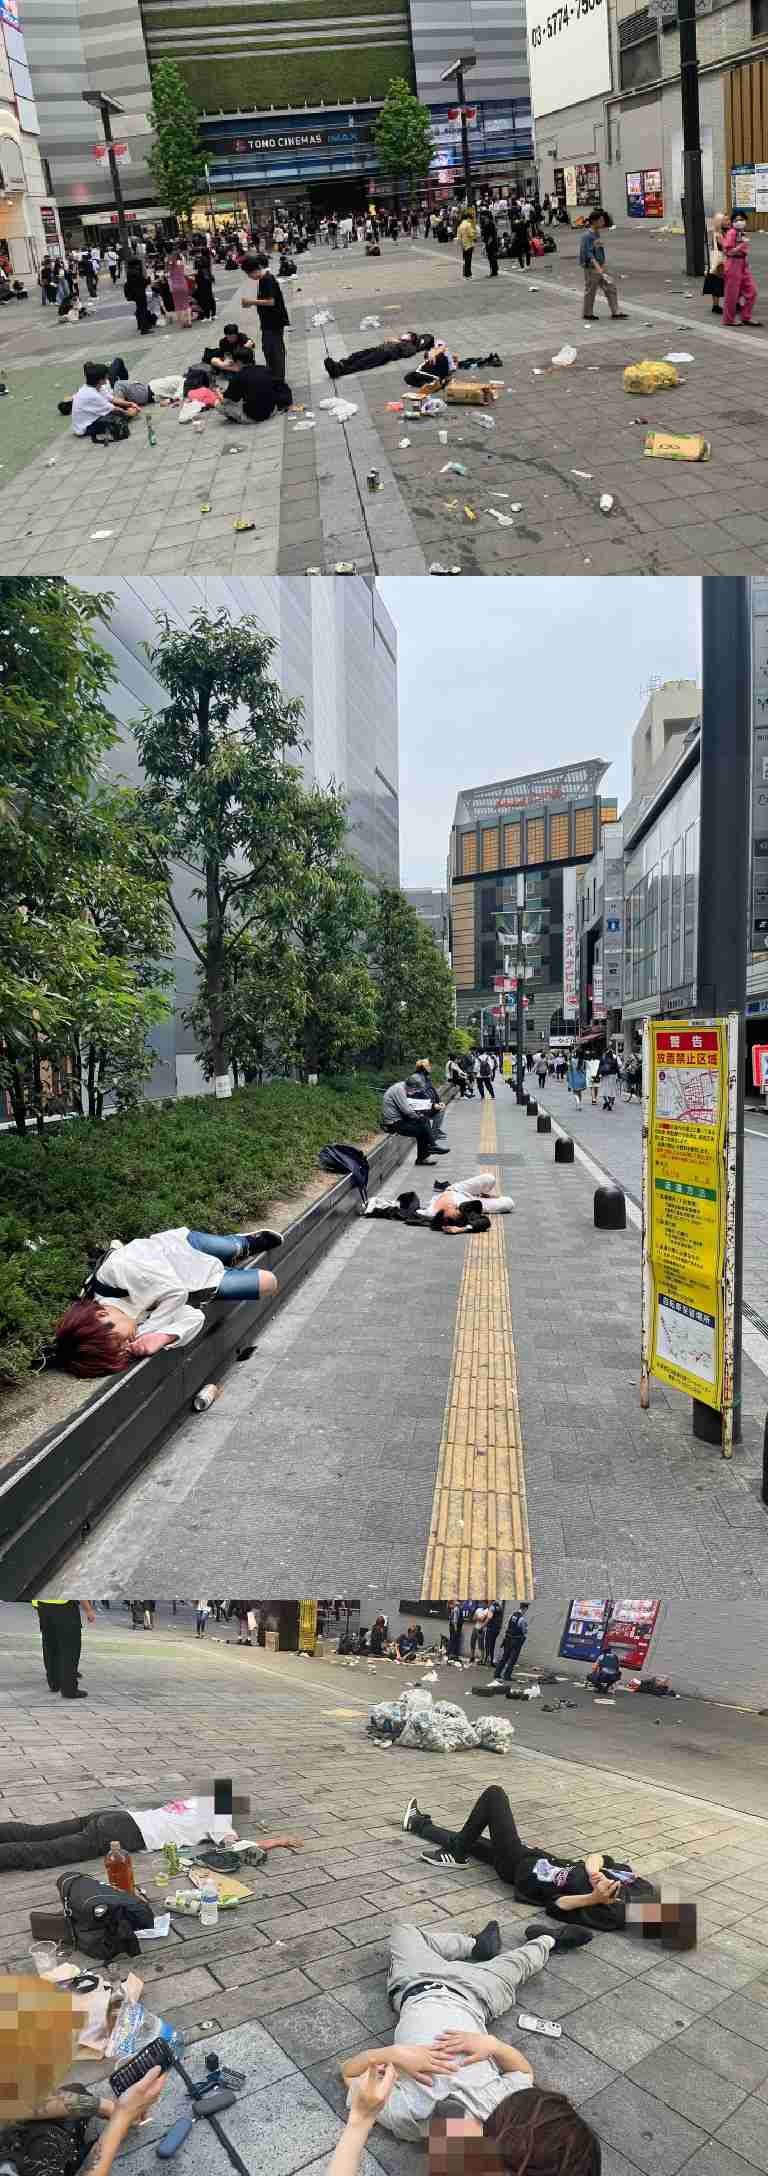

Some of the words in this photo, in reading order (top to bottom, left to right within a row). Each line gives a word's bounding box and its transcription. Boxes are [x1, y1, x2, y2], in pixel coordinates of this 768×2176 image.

[248, 139, 276, 150] TOHO
[278, 135, 321, 147] CINEMAS
[670, 1035, 703, 1048] 警告
[656, 1053, 718, 1065] 放置禁止区域
